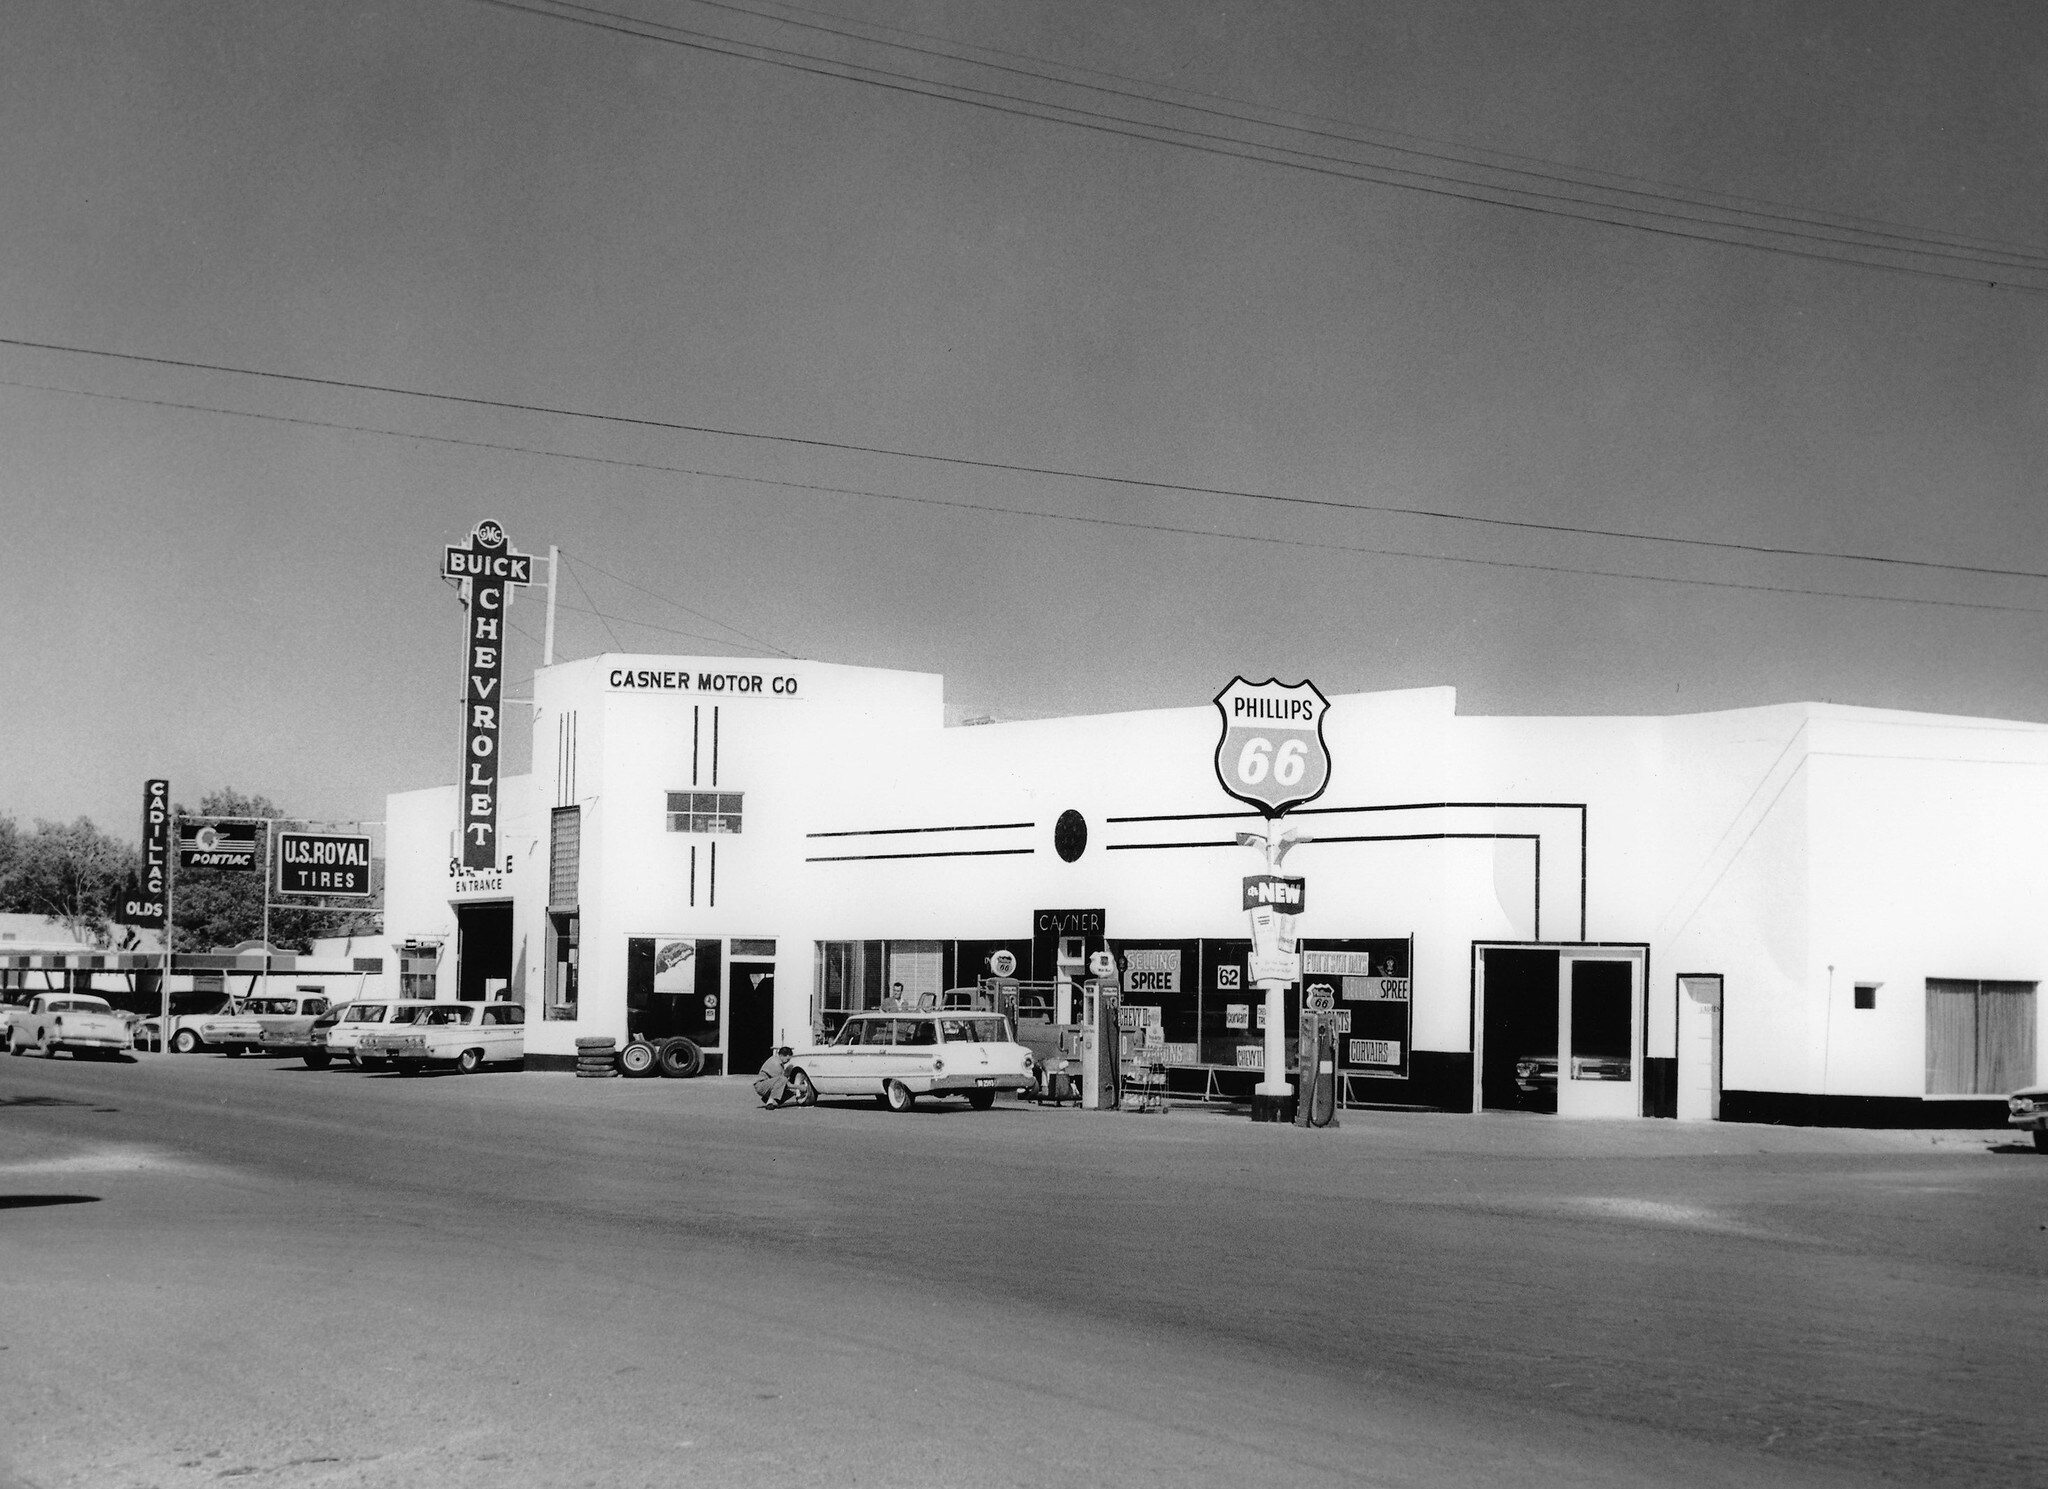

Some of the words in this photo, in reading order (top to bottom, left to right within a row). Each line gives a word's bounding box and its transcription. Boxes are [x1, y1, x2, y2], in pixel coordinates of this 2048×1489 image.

[480, 526, 501, 542] GMC
[450, 552, 527, 580] BUICK
[610, 670, 690, 689] CASNER
[698, 673, 763, 692] MOTOR
[772, 676, 798, 694] CO
[467, 588, 500, 846] CHEVROLET
[1234, 697, 1313, 721] PHILLIPS
[1237, 737, 1308, 786] 66
[148, 782, 165, 893] CADILLAC
[190, 853, 251, 866] PONTIAC
[298, 871, 354, 888] TIRES
[456, 879, 502, 892] ENTRANCE
[1258, 882, 1301, 904] NEW
[126, 901, 163, 917] OLDS
[1039, 913, 1100, 931] CASNER
[1127, 953, 1177, 970] SELLING
[1131, 972, 1172, 989] SPREE
[1219, 967, 1239, 986] '62
[1380, 980, 1408, 999] SPREE
[1315, 998, 1329, 1008] 66
[1350, 1041, 1389, 1062] CORVAIRS
